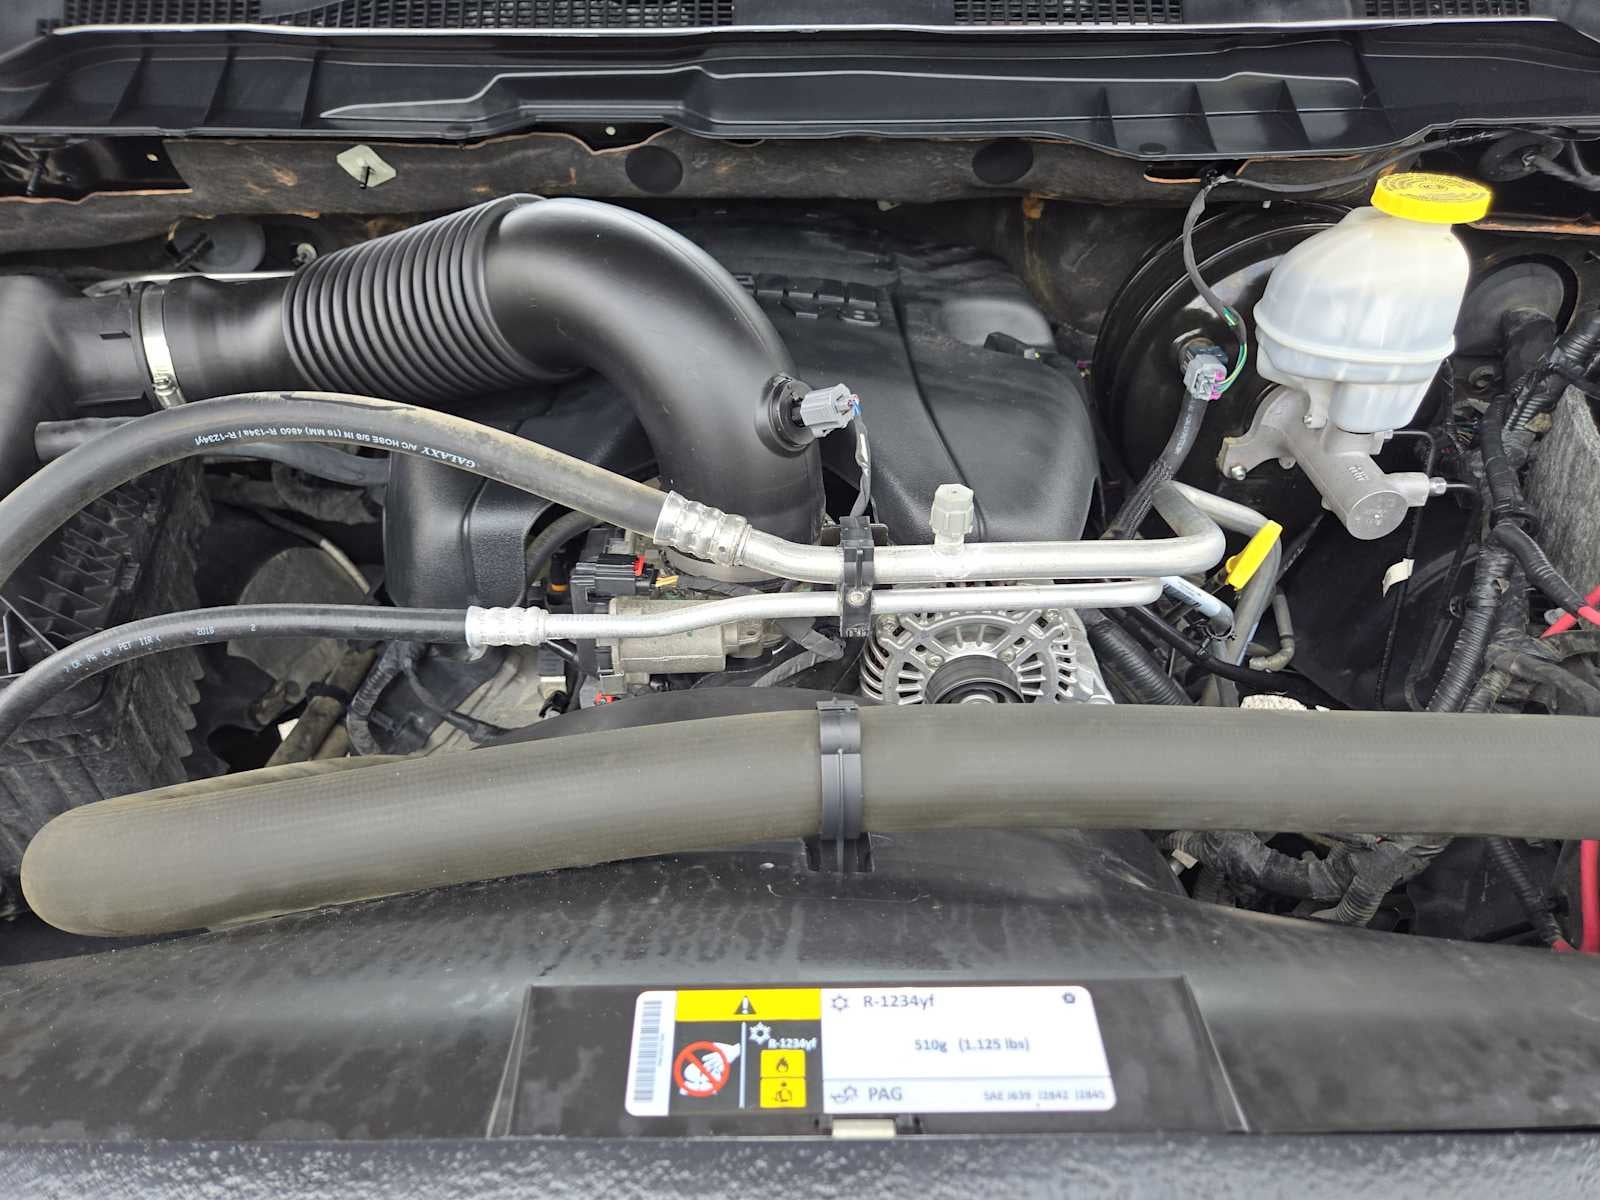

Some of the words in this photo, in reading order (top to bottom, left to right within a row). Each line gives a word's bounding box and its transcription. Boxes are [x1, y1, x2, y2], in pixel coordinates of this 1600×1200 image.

[243, 428, 278, 436] R-134a
[305, 426, 326, 436] MM)
[343, 431, 354, 440] IN
[356, 433, 371, 441] 5/8
[194, 431, 238, 446] R-1234yf
[371, 434, 400, 448] HOSE
[401, 441, 417, 451] A/C
[421, 446, 476, 468] GALAXY
[863, 993, 934, 1010] R-1234yf
[768, 1037, 817, 1052] R-1234yf
[914, 1039, 947, 1053] 510g
[958, 1037, 1001, 1053] (1.125
[1005, 1037, 1030, 1052] lbs)
[868, 1086, 903, 1101] PAG
